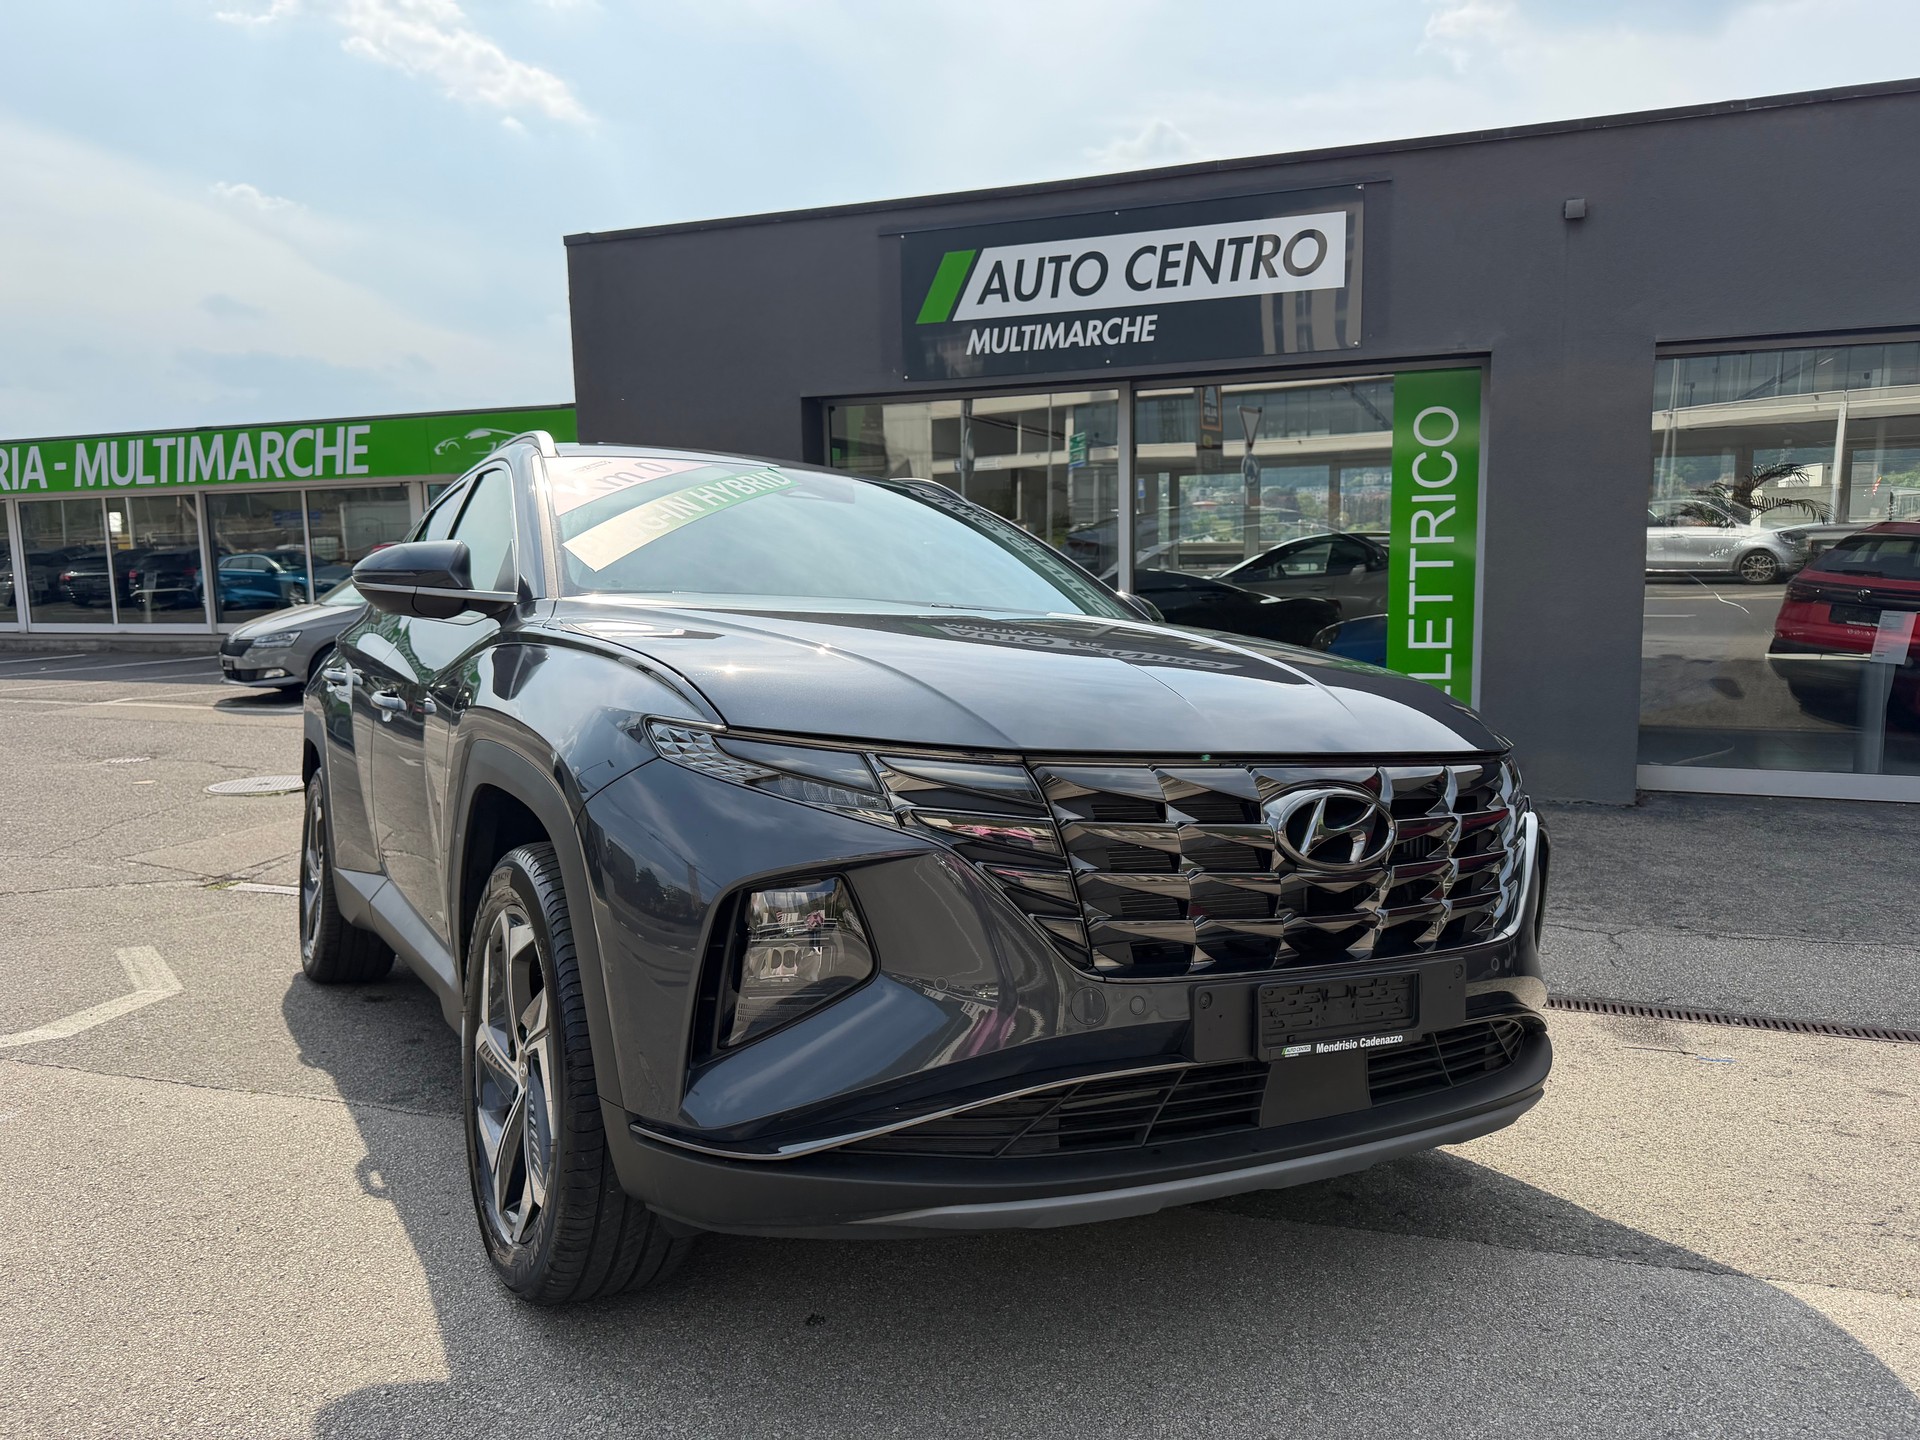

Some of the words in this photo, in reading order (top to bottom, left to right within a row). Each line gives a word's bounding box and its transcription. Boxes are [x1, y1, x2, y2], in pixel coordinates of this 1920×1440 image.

[977, 250, 1109, 305] AUTO
[1125, 228, 1328, 292] CENTRO
[966, 314, 1158, 356] MULTIMARCHE
[74, 425, 371, 488] MULTIMARCHE
[693, 470, 792, 507] HYBRID
[1407, 405, 1459, 695] LETTRICO
[1315, 1038, 1358, 1054] Mendrisio
[1359, 1033, 1404, 1048] Cadenazzo
